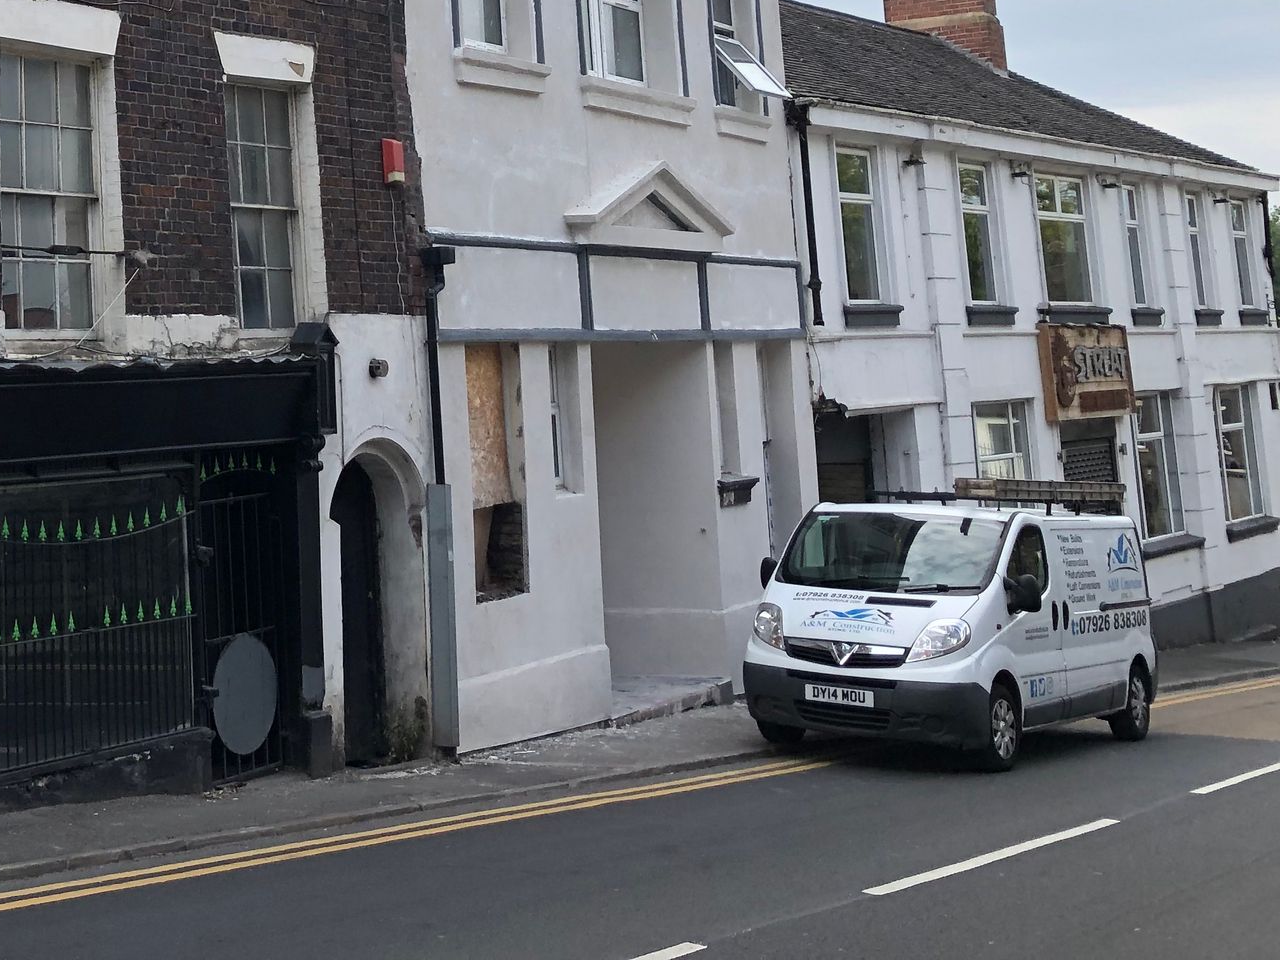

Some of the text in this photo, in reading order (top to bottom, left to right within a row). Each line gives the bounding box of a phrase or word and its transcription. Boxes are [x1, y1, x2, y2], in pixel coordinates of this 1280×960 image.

[1074, 345, 1127, 382] STREAT
[832, 621, 895, 635] Construction
[1113, 610, 1147, 630] 838308
[812, 686, 866, 703] DY14 MOU
